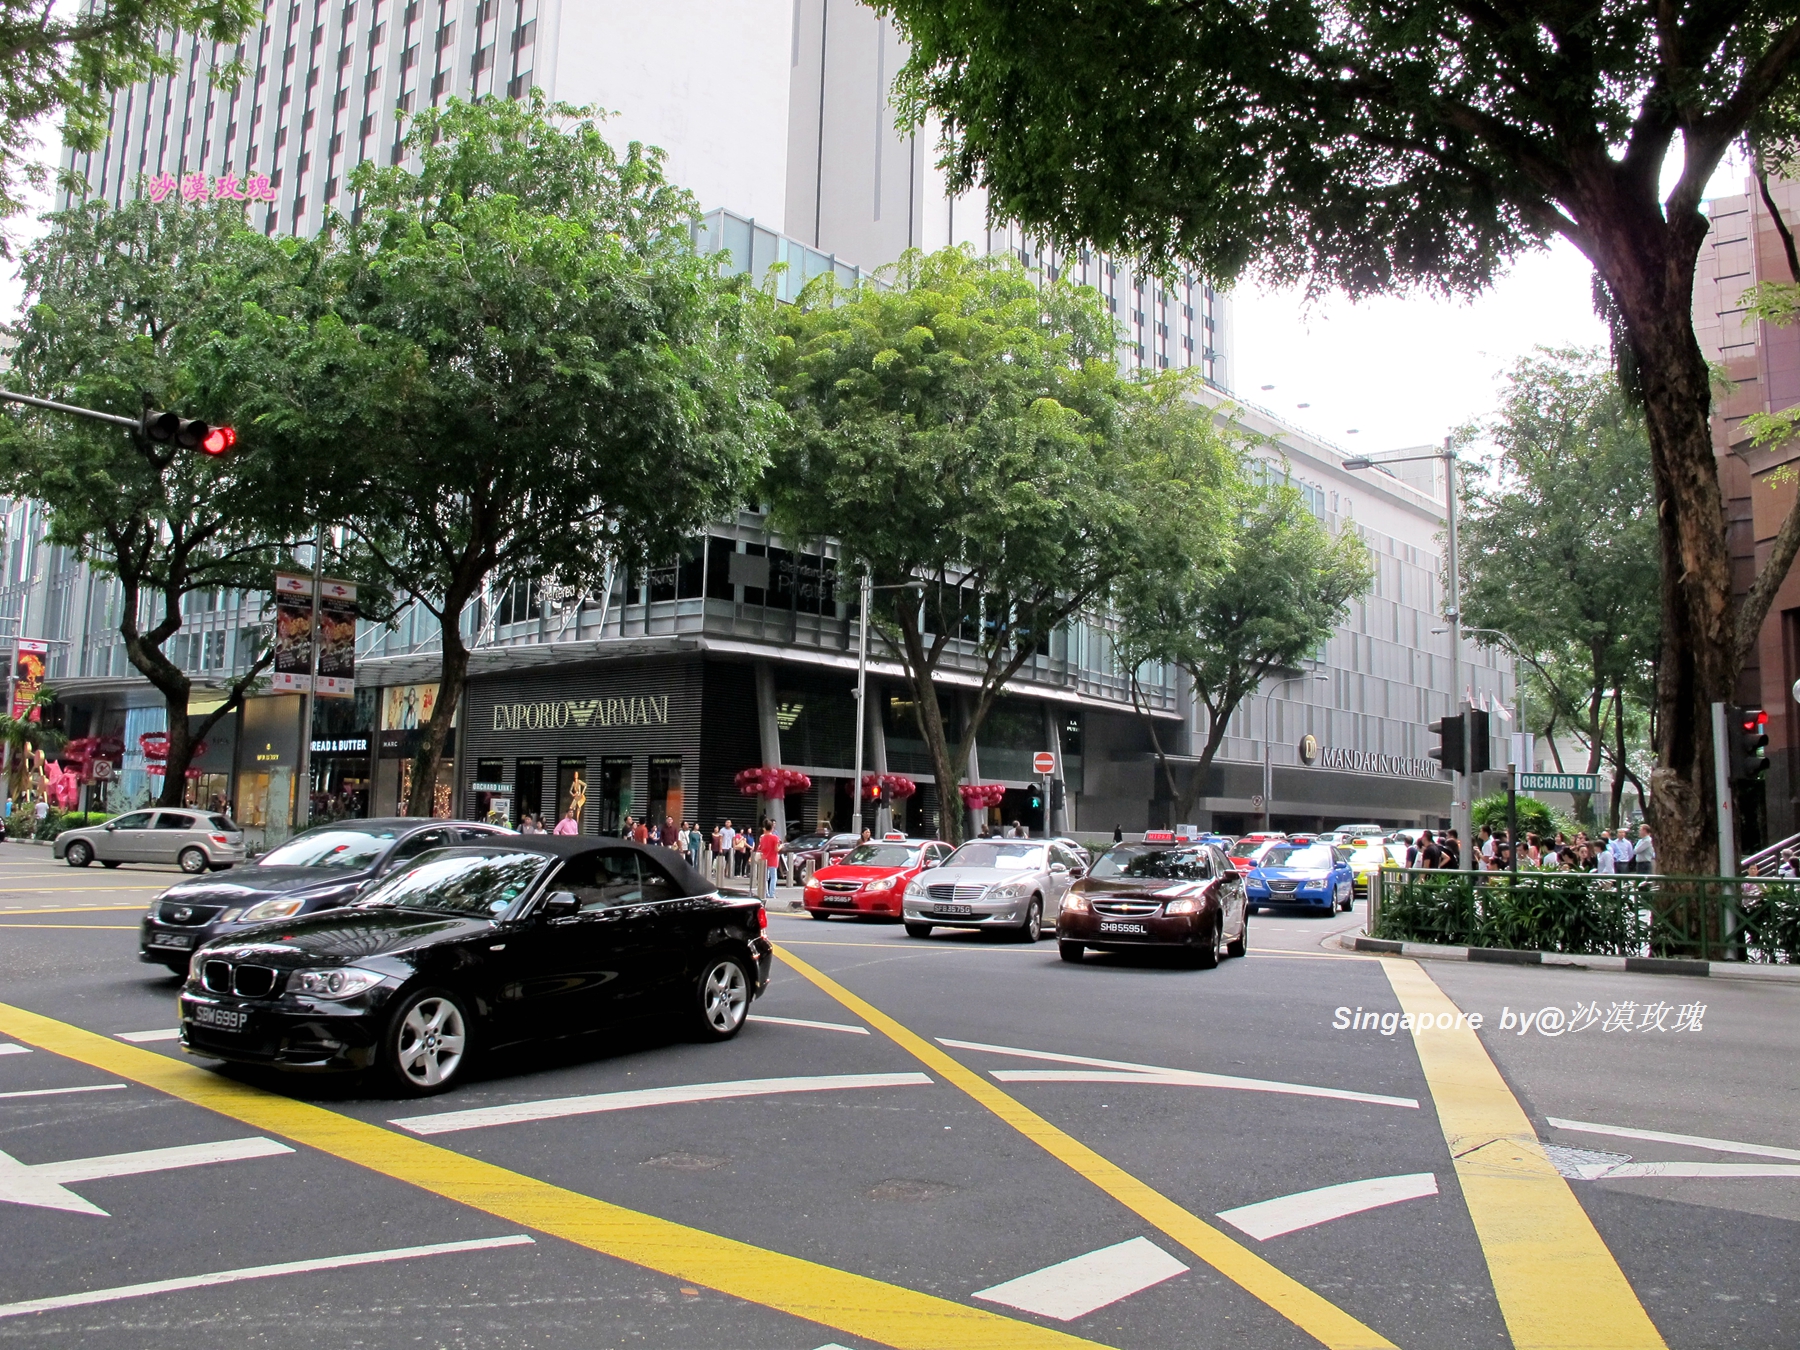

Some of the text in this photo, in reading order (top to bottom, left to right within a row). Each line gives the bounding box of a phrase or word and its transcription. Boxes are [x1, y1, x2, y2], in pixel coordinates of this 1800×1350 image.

[492, 695, 669, 731] EMPORIO ARMANI
[310, 739, 367, 752] READ & BUTTER
[1321, 746, 1436, 779] MANDARIN ORCHARD
[472, 783, 497, 791] ORCHARD
[1522, 775, 1593, 790] ORCHARD RD
[1461, 802, 1466, 810] 5
[1722, 801, 1727, 810] 4
[934, 905, 971, 913] SFB3575G
[1100, 922, 1147, 934] SHB5595L
[196, 1005, 248, 1028] SBW699P
